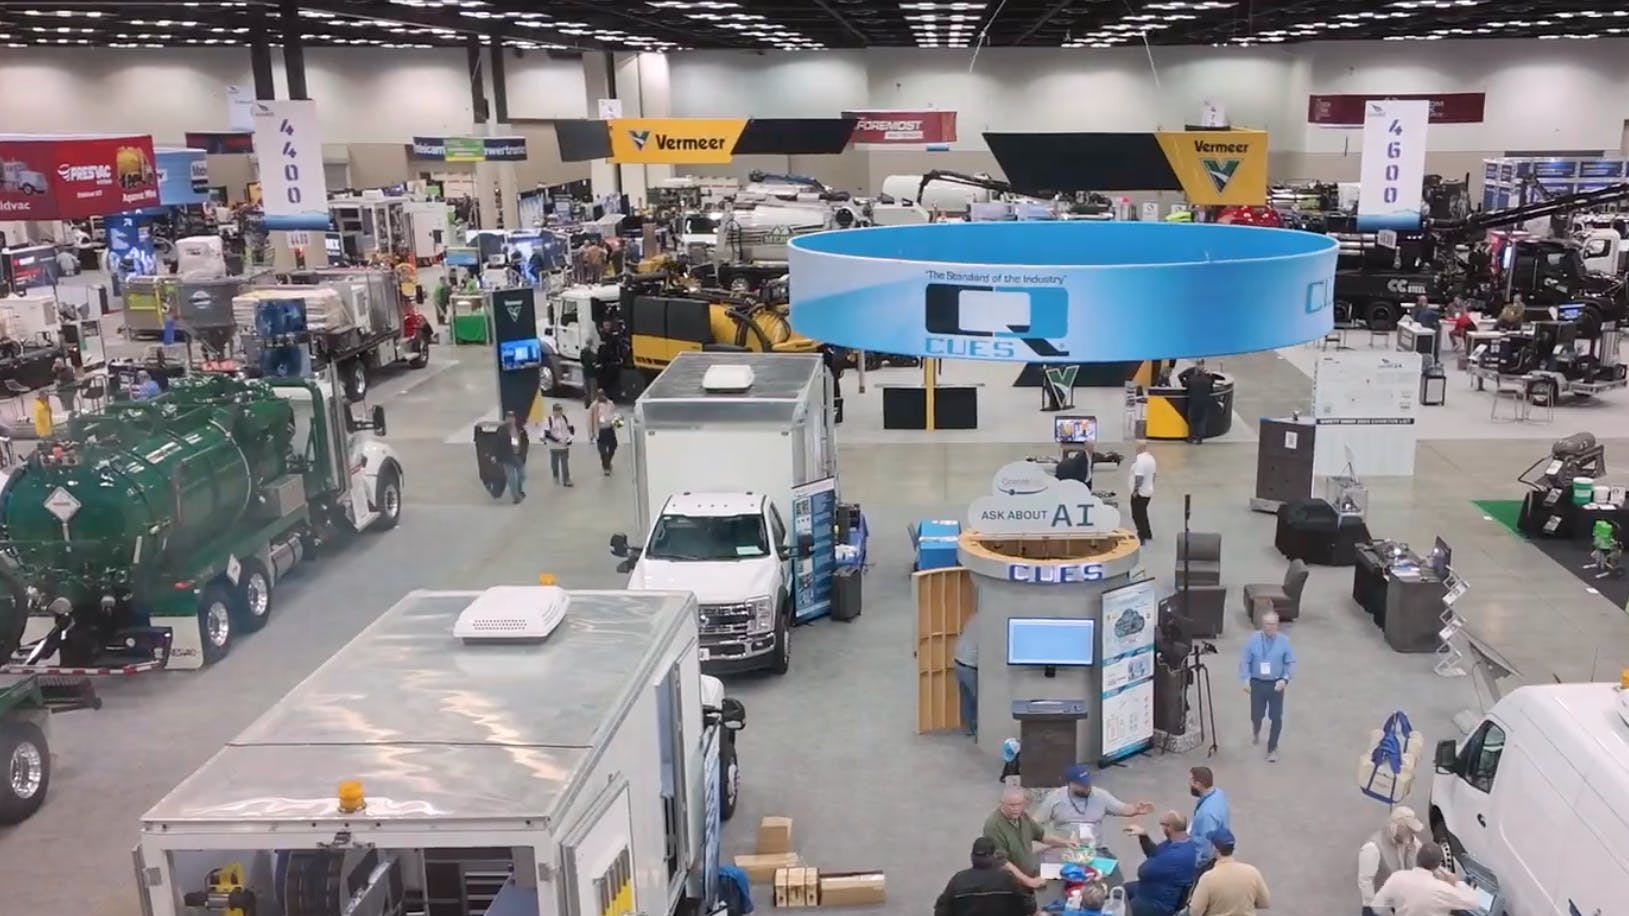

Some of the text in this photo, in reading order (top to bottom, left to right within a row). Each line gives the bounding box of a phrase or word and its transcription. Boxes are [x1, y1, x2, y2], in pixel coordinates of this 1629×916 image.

[856, 120, 923, 131] FOREMOST
[656, 134, 725, 150] Vermeer
[1194, 140, 1248, 152] Vermeer
[280, 119, 301, 204] 4400
[1384, 119, 1402, 203] 4600
[946, 271, 989, 283] Standard
[992, 274, 1002, 283] of
[1004, 274, 1021, 284] the
[926, 338, 1014, 357] CUES
[981, 504, 1095, 527] ASK ABOUT AI
[1009, 564, 1103, 583] CUES
